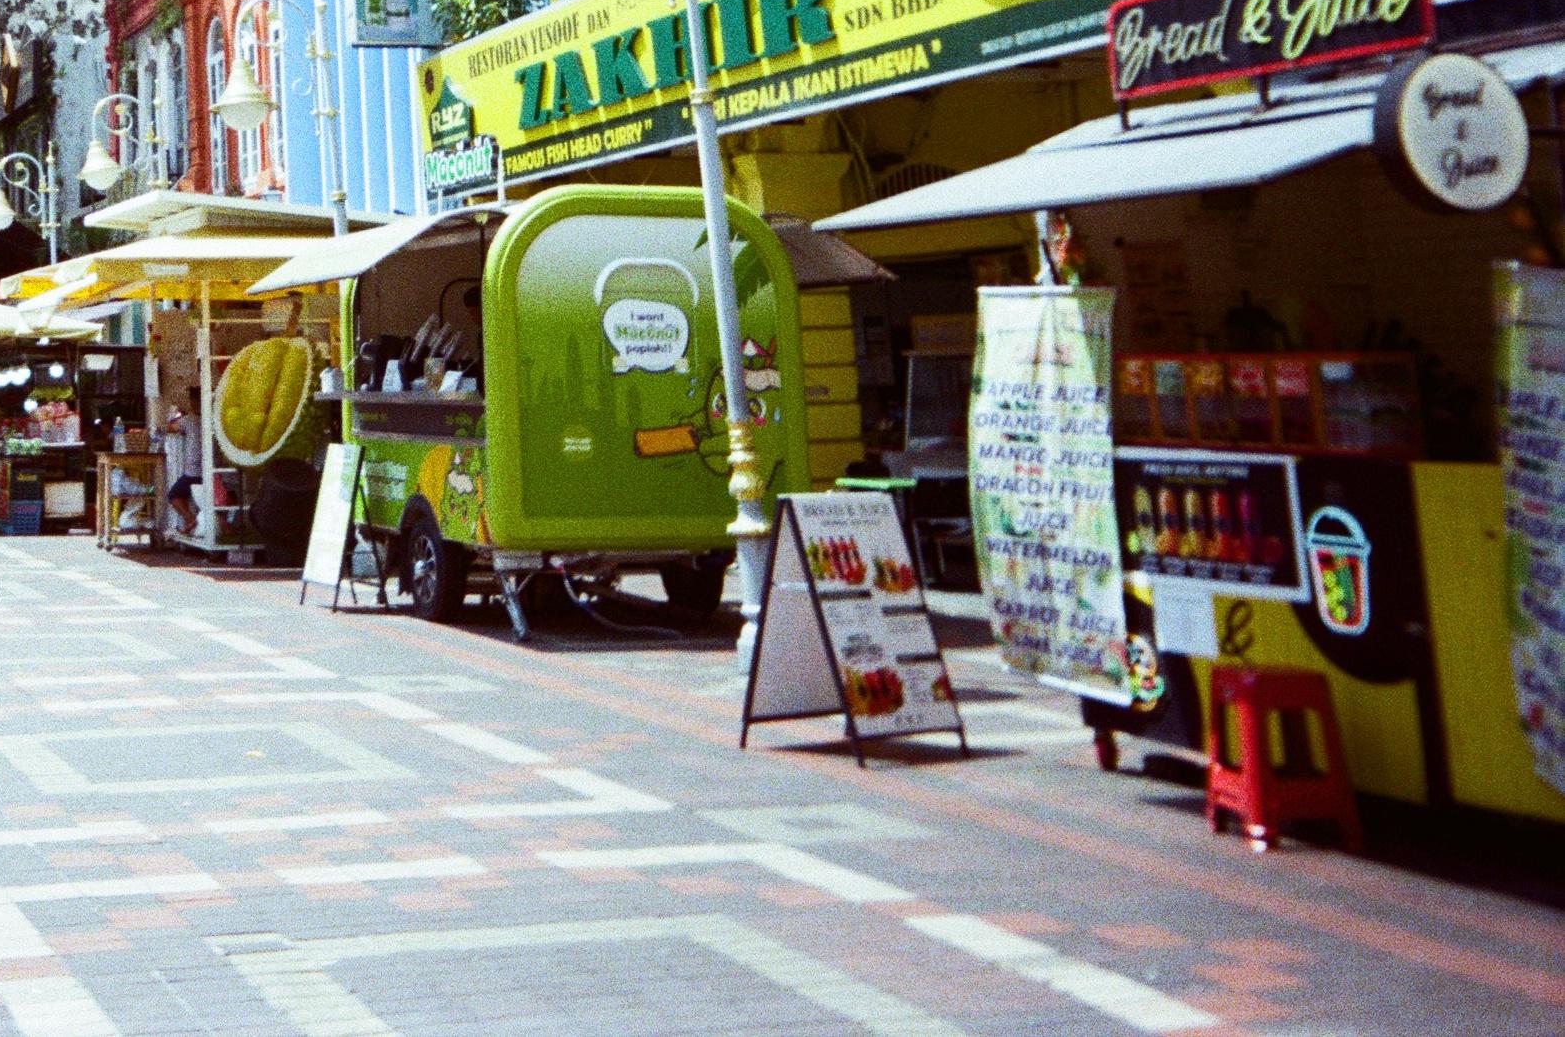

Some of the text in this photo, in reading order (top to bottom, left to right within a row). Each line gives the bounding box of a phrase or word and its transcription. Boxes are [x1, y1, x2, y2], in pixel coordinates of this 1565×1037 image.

[843, 0, 884, 33] SDN
[468, 9, 610, 79] RESTORAN YUSOOF DAN
[729, 83, 791, 119] KEPALA
[794, 69, 836, 100] IKAN
[506, 149, 544, 175] FAMOUS
[547, 142, 568, 166] FISH
[571, 135, 601, 159] HEAD
[636, 311, 665, 321] want
[988, 382, 1044, 400] APPLE
[975, 412, 1055, 432] ORANGE
[986, 537, 1114, 569] WATERMELON
